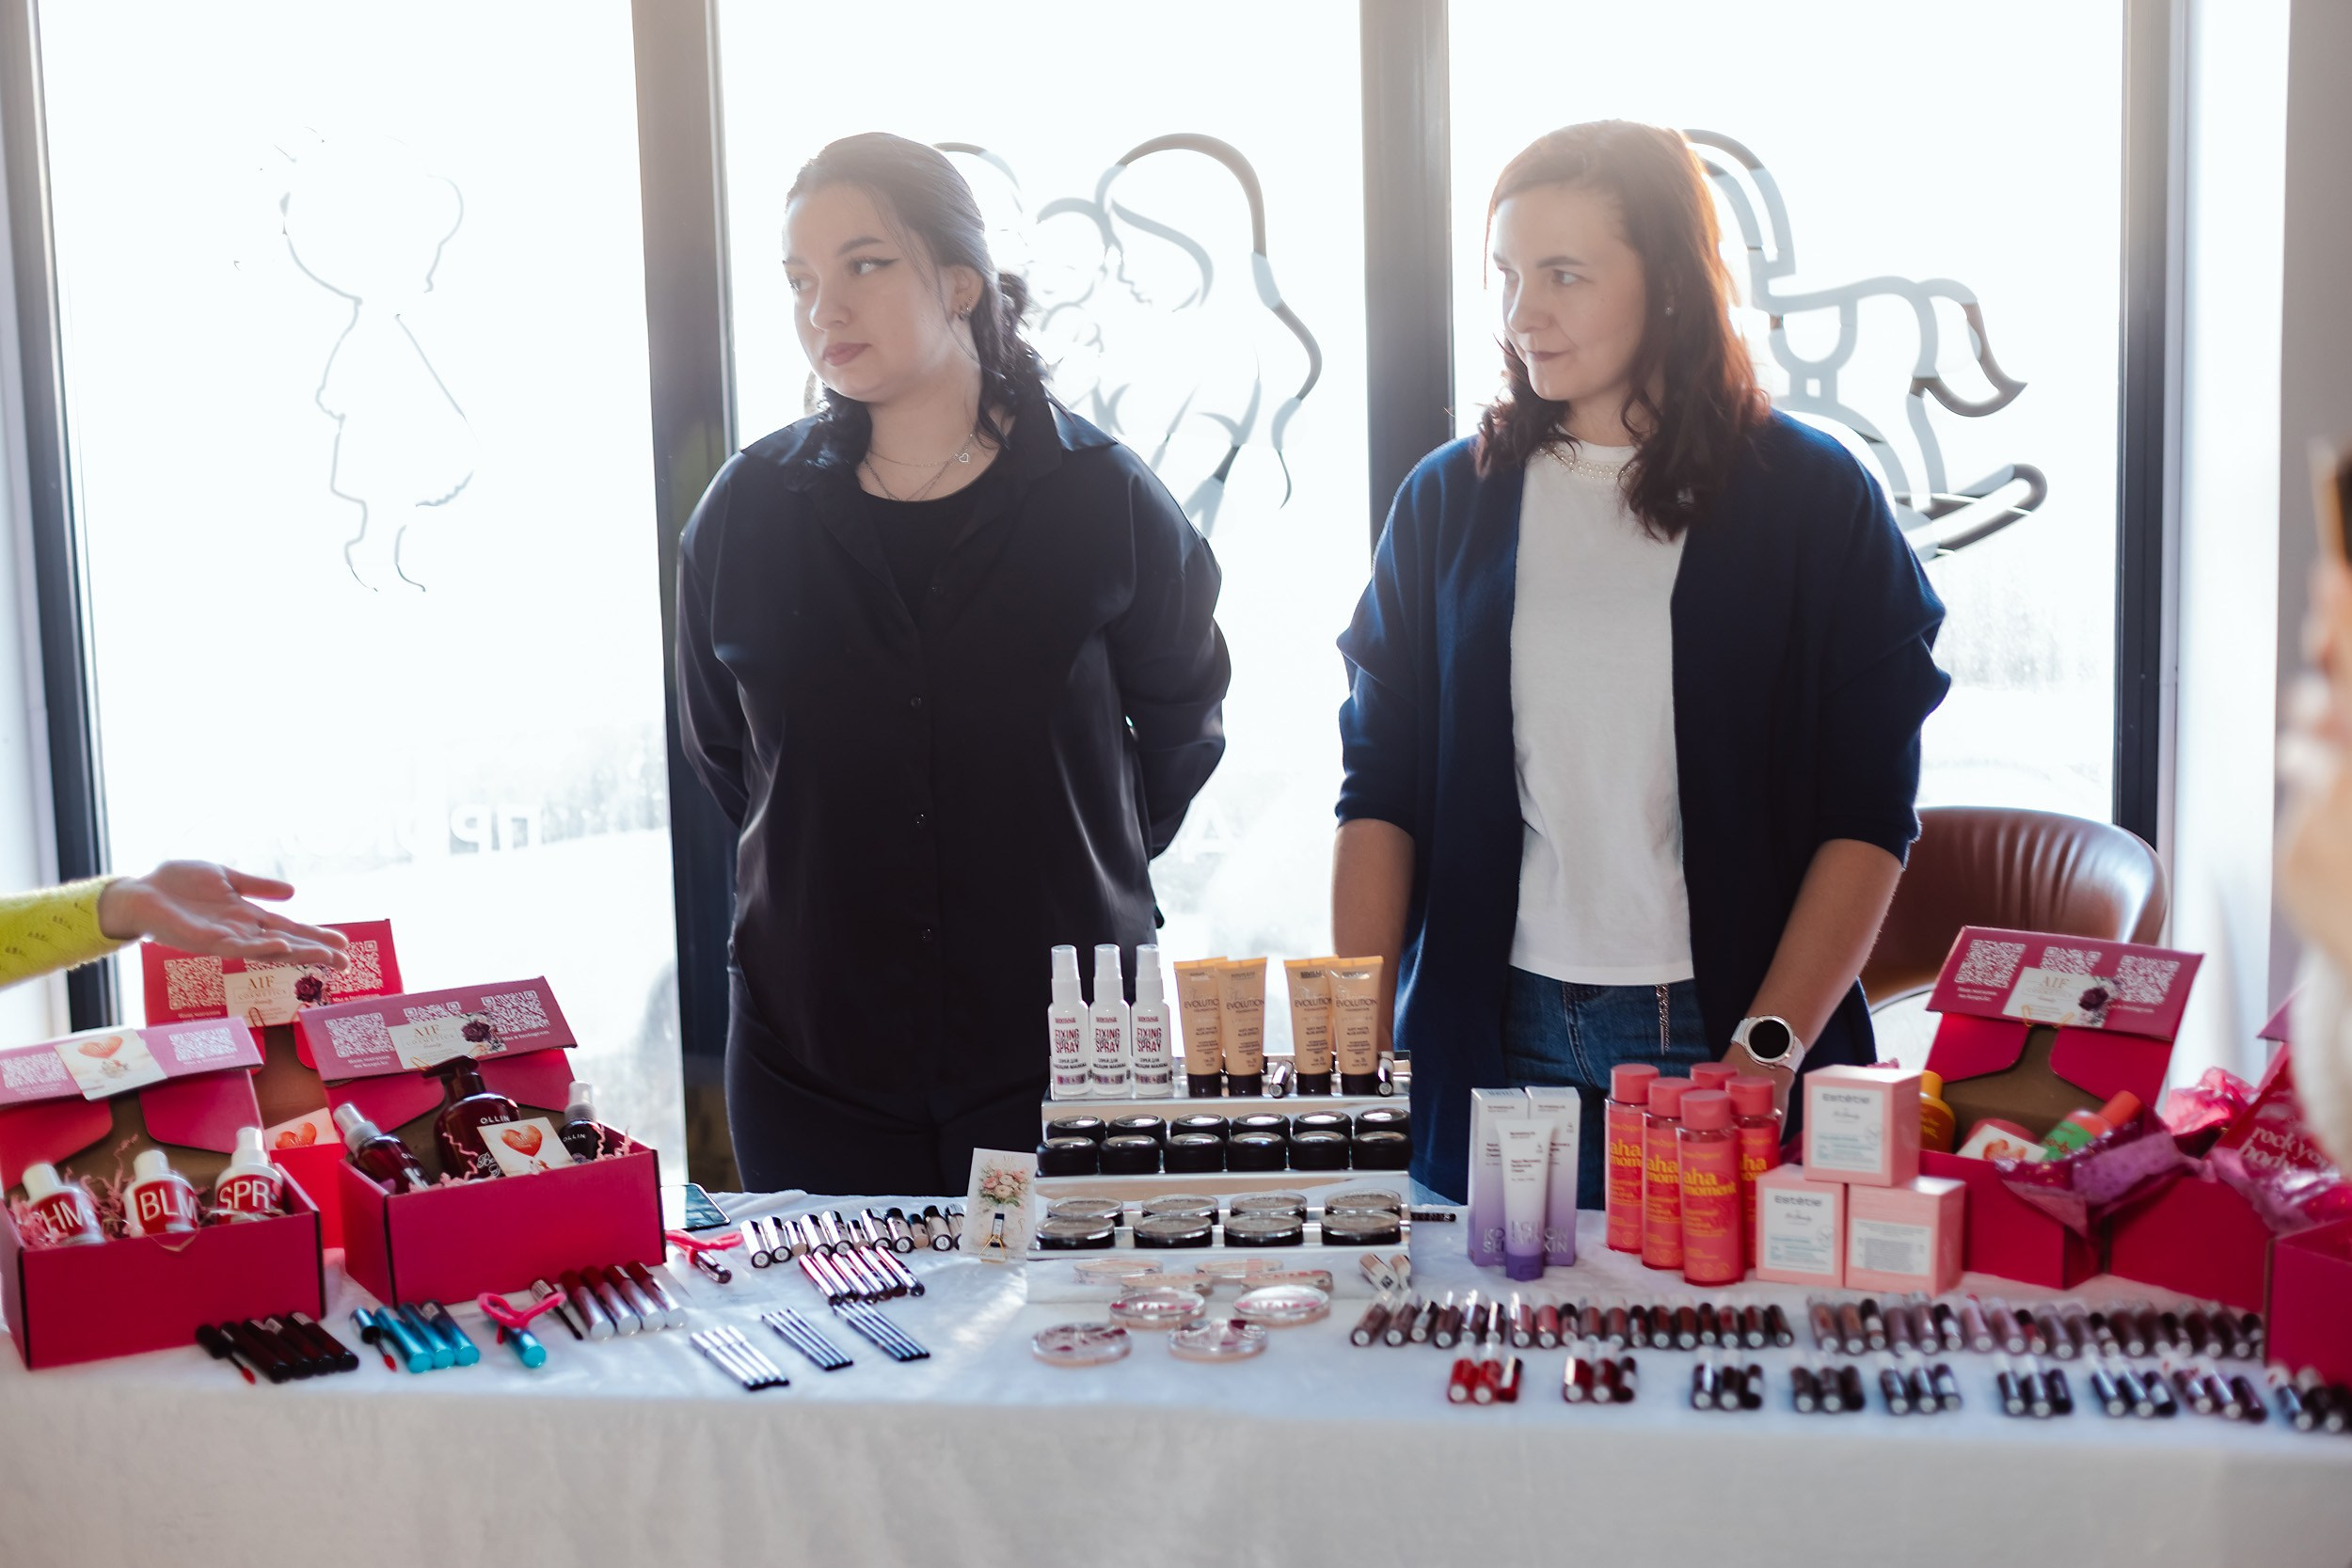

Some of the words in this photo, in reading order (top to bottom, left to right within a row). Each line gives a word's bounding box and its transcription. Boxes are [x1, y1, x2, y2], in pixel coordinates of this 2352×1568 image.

[1184, 998, 1219, 1008] EVOLUTIO
[1055, 1028, 1079, 1039] FIXING
[1095, 1028, 1120, 1039] FIXING
[1136, 1027, 1162, 1039] FIXING
[1055, 1039, 1079, 1053] SPRAY
[1095, 1039, 1120, 1053] SPRAY
[1136, 1039, 1162, 1053] SPRAY
[480, 1115, 510, 1124] OLLIN
[563, 1133, 586, 1142] OLLIN
[1610, 1138, 1641, 1156] aha
[1610, 1157, 1642, 1167] mom
[1646, 1154, 1678, 1173] aha
[1646, 1173, 1678, 1184] mom
[1683, 1166, 1718, 1185] aha
[1683, 1180, 1737, 1196] moment
[139, 1188, 200, 1225] BLM
[38, 1200, 83, 1236] HM
[1483, 1241, 1505, 1253] SKI
[1544, 1241, 1567, 1253] KIN
